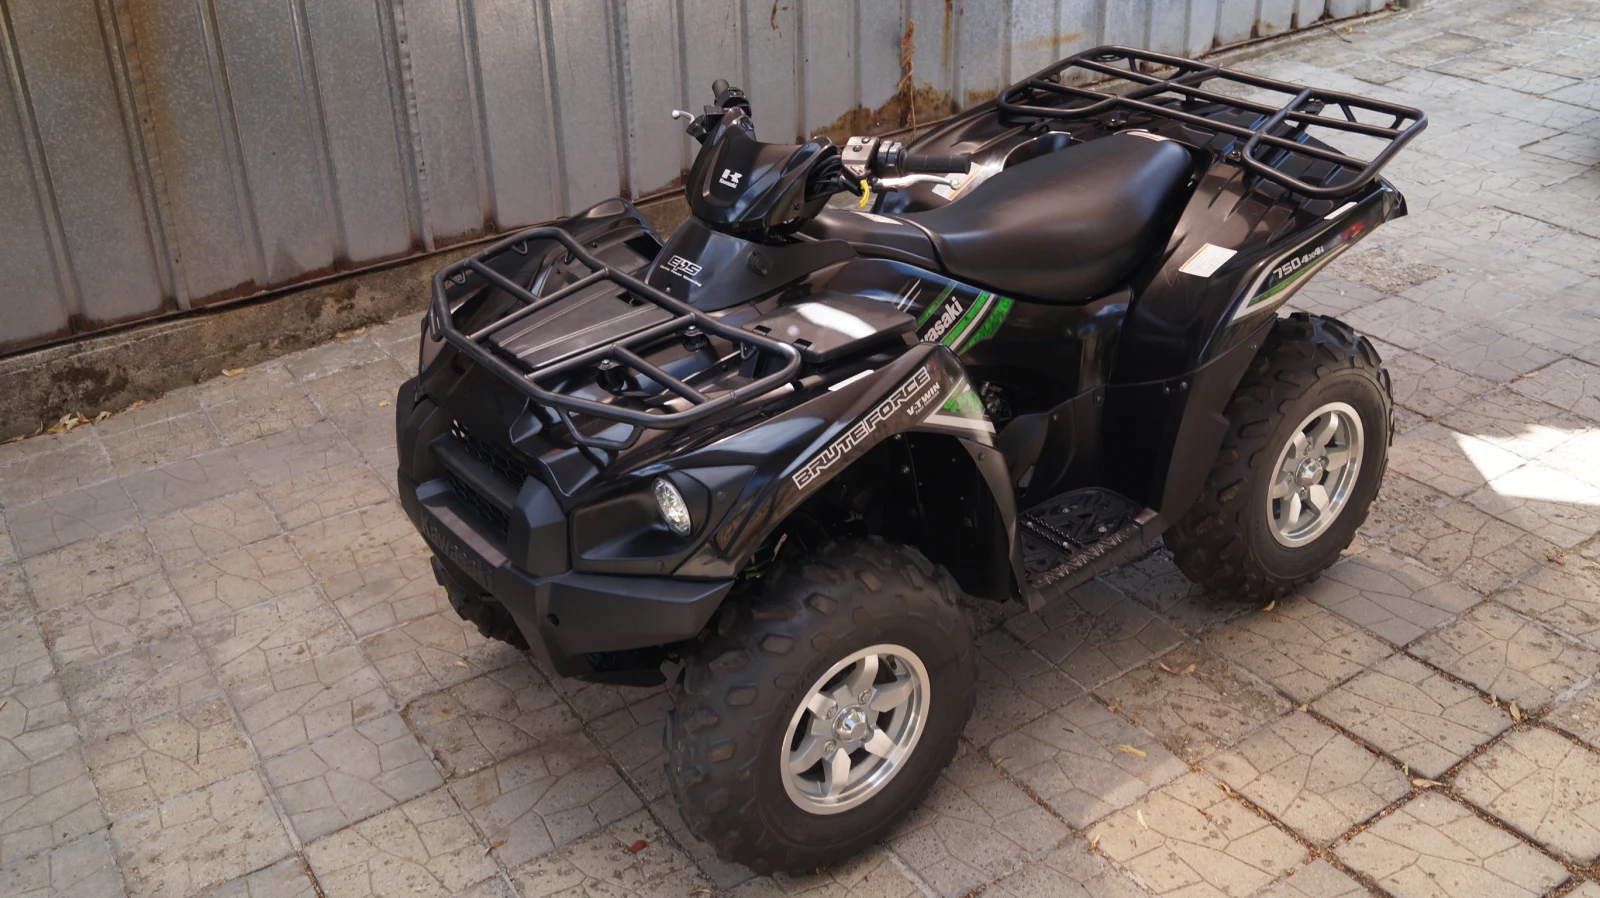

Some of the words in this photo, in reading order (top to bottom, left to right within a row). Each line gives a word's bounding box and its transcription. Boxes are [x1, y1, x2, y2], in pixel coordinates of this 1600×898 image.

[667, 254, 703, 276] EPS
[1272, 257, 1302, 279] 750
[1301, 245, 1325, 264] 4x4i
[920, 295, 964, 342] asaki
[906, 381, 940, 416] V-TWIN
